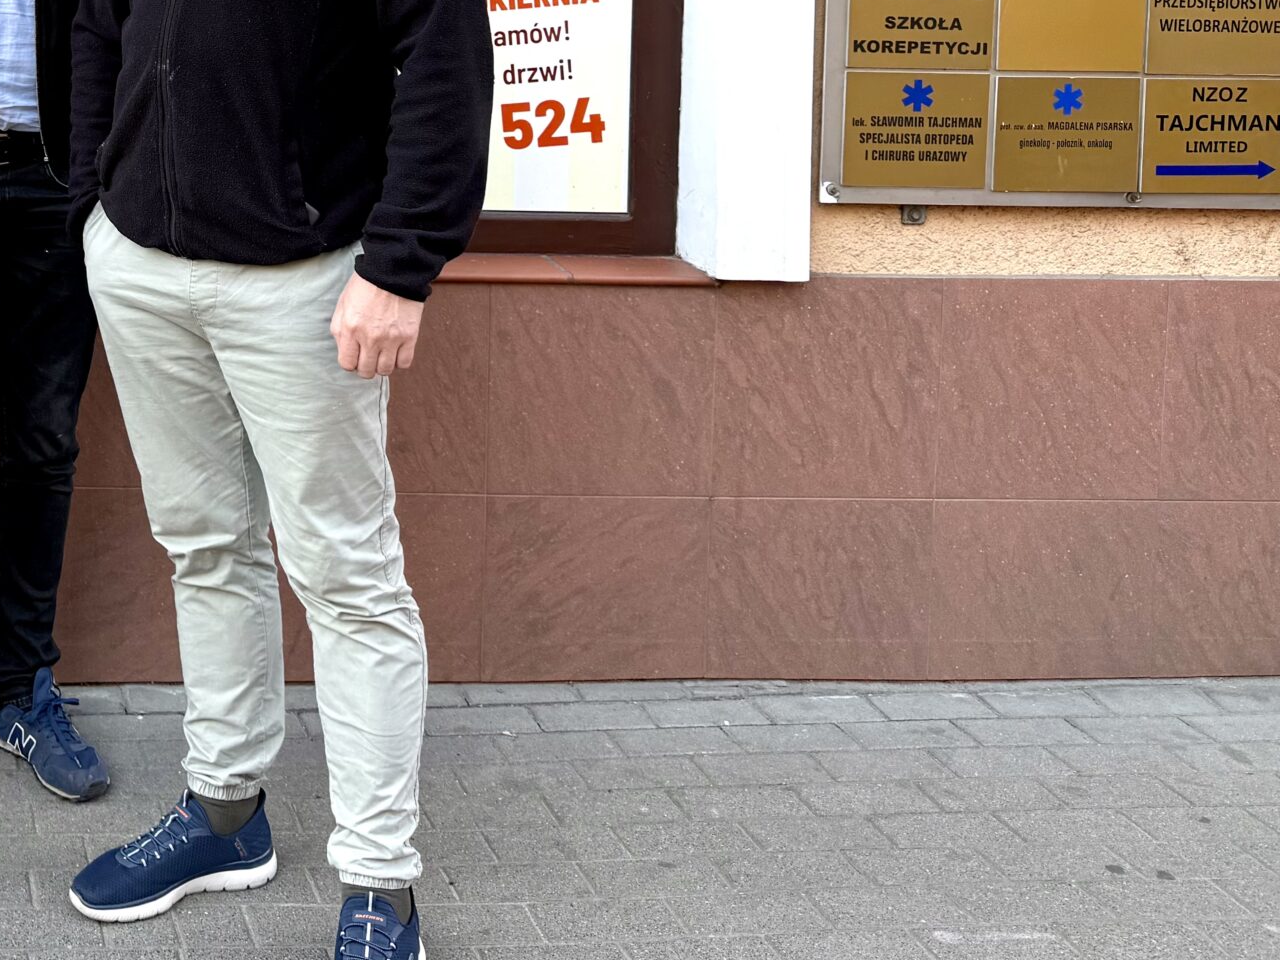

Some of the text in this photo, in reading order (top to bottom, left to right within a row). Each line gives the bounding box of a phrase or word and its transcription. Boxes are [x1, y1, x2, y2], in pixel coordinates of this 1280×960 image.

[884, 16, 963, 31] SZKOŁA
[1159, 16, 1280, 34] WIELOBRANŻOWE
[493, 20, 570, 47] amów!
[852, 40, 988, 56] KOREPETYCJI
[503, 59, 573, 85] drzwi!
[501, 97, 606, 150] 524
[852, 116, 982, 128] lek. SŁAWOMIR TAJCHMAN
[1047, 121, 1094, 131] MAGDALENA
[1096, 121, 1133, 131] PISARSKA
[1156, 115, 1280, 132] TAJCHMAN
[859, 132, 974, 145] SPECJALISTA ORTOPEDA
[1019, 138, 1113, 150] ginekolog onkolog
[1186, 141, 1248, 153] LIMITED
[871, 149, 968, 162] CHIRURG URAZOWY
